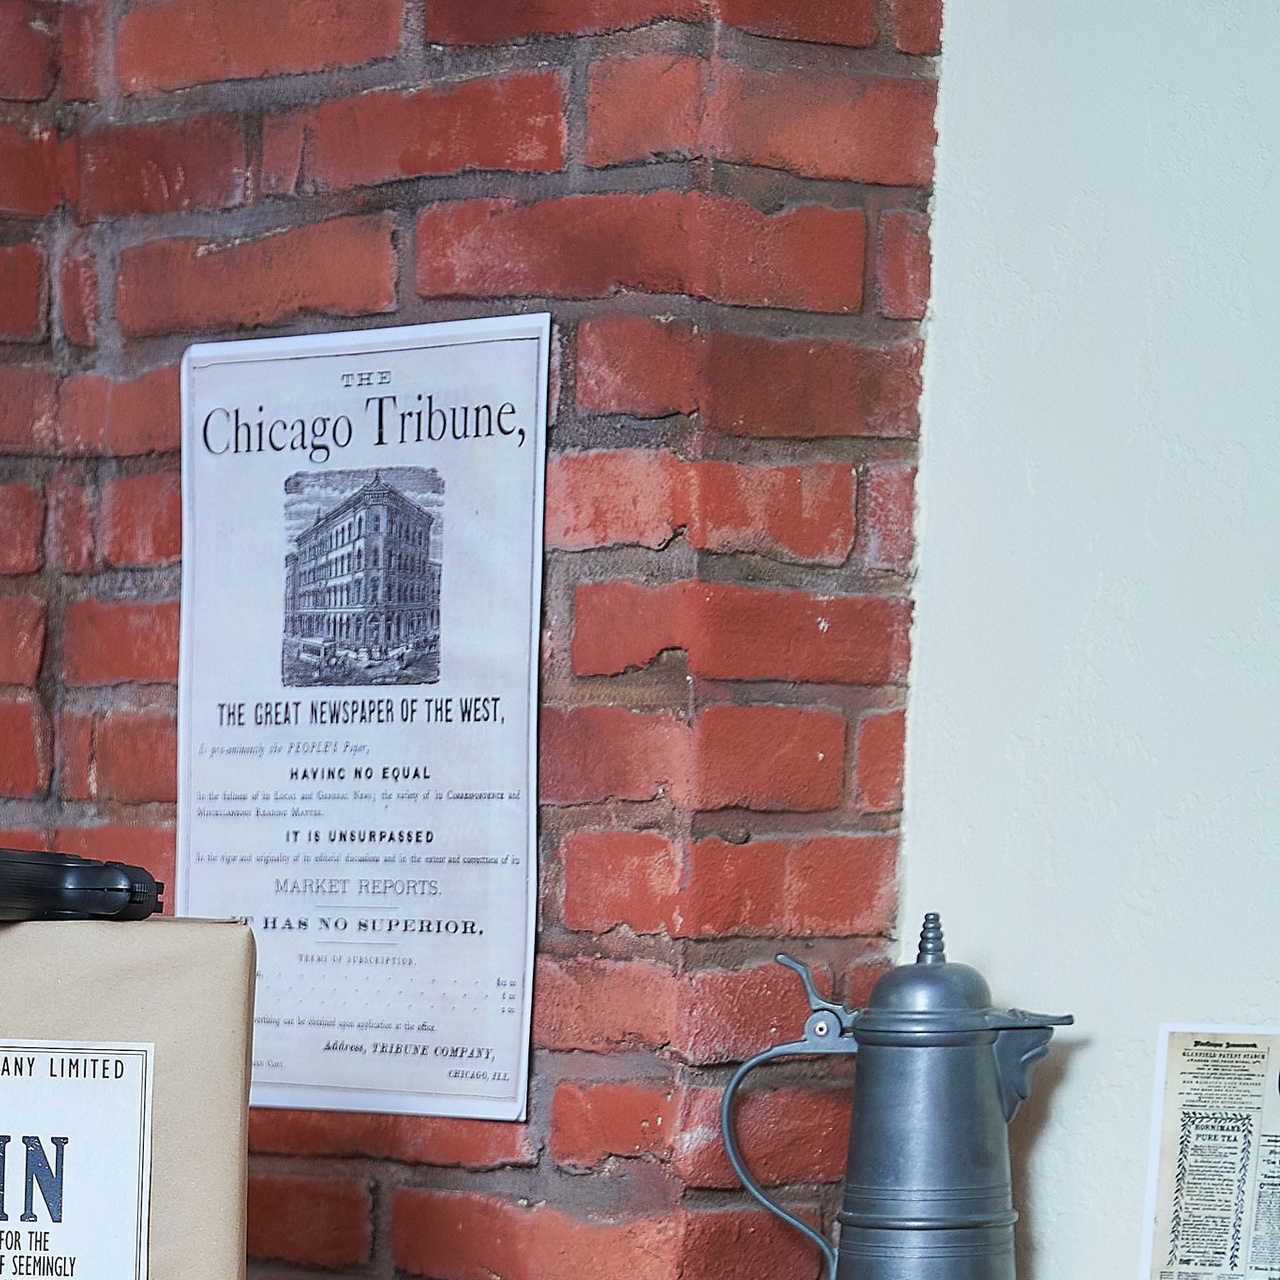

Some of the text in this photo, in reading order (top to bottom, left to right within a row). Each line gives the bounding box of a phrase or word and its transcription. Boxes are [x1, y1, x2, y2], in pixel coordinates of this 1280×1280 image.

[341, 371, 392, 386] THE
[203, 395, 525, 463] Chicago Tribune,
[218, 698, 505, 726] THE GREAT NEWSPAPER OF THE WEST,
[291, 766, 431, 781] HAVING NO EQUAL
[286, 831, 434, 843] IT IS UNSURPASSED
[275, 878, 442, 896] MARKET REPORTS.
[263, 918, 484, 935] HAS NO SUPERIOR.
[324, 1041, 495, 1062] Address, TRIBUNE COMPANY,
[50, 1057, 125, 1079] LIMITED
[0, 1230, 21, 1250] FOR
[28, 1231, 50, 1251] THE
[12, 1256, 76, 1277] SEEMINGLY
